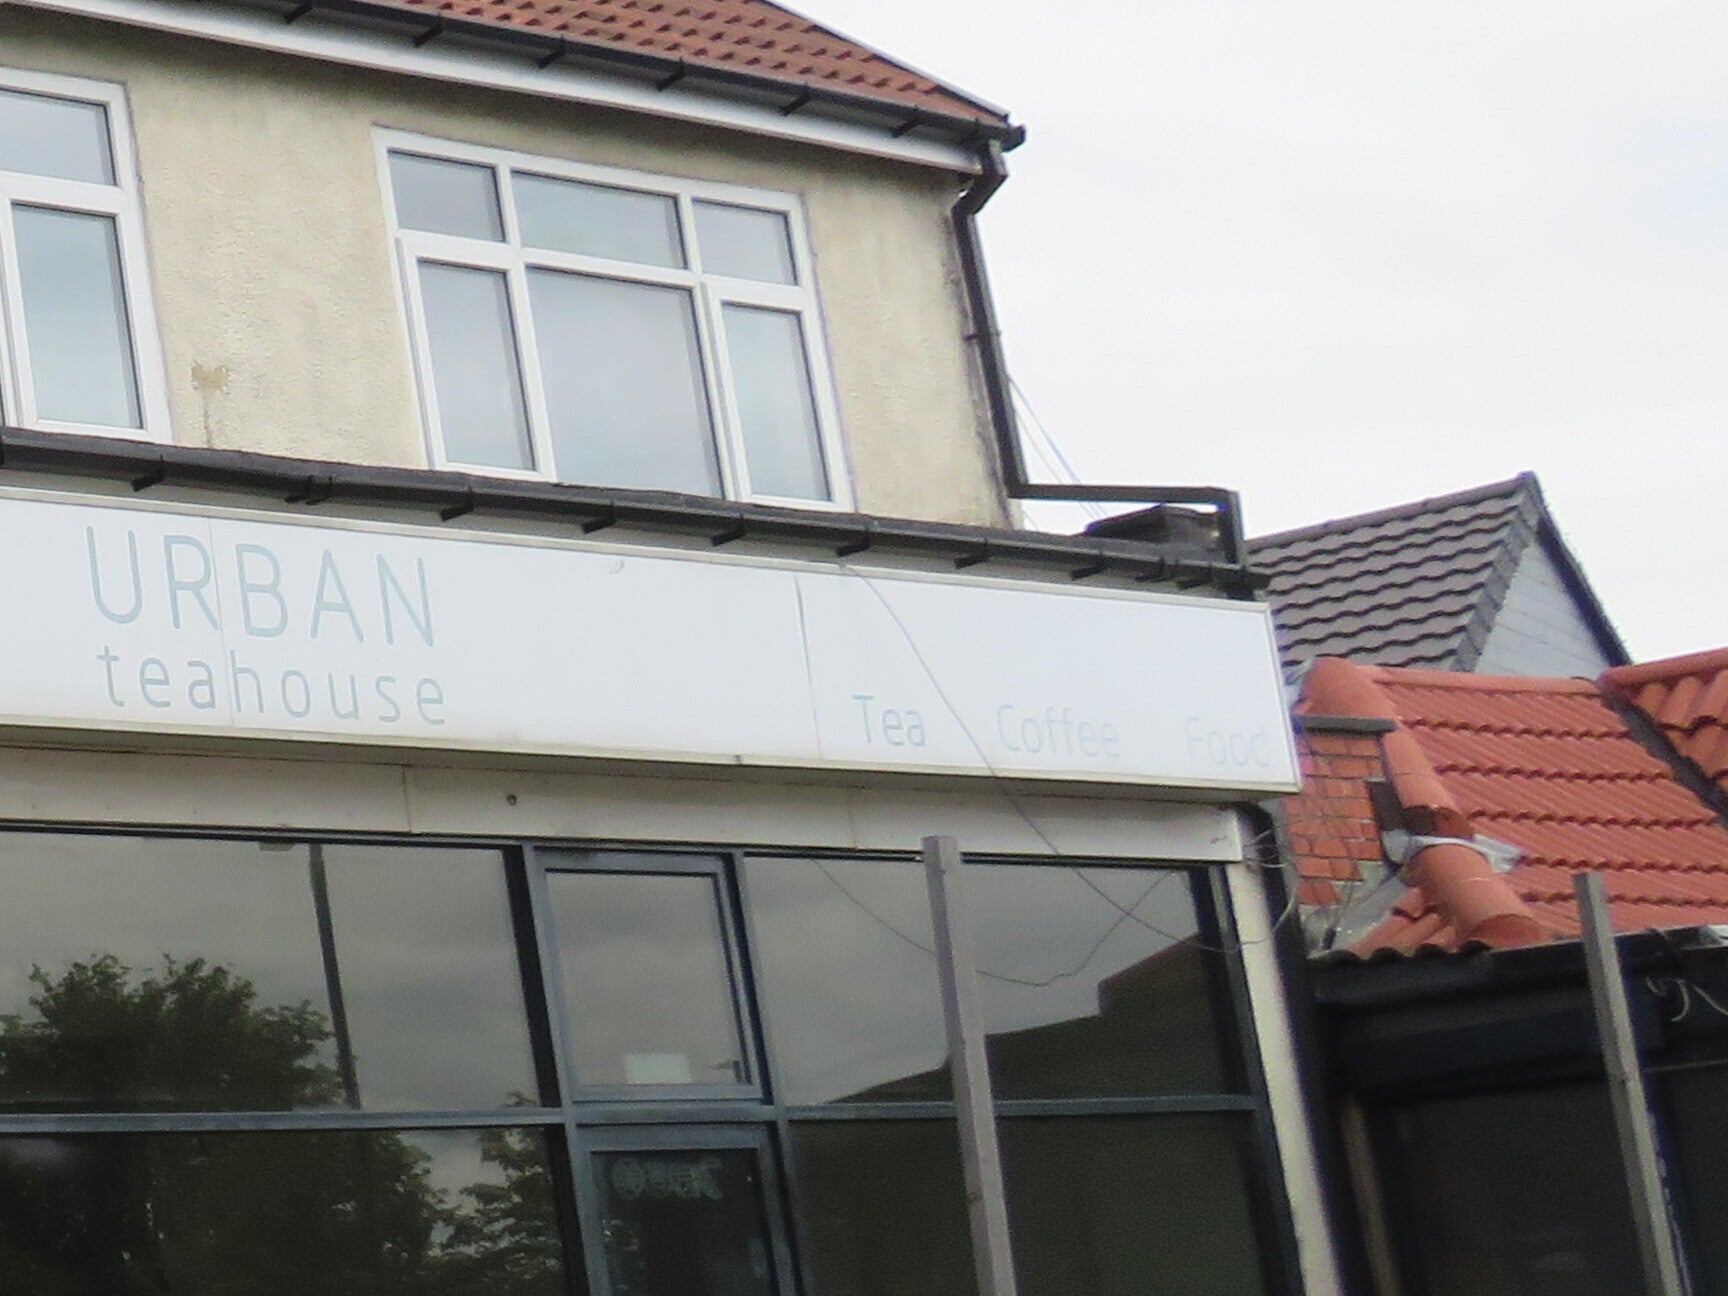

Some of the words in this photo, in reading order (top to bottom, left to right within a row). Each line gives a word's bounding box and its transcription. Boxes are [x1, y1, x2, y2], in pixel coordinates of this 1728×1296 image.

[87, 525, 435, 649] URBAN
[96, 644, 447, 727] teahouse
[851, 693, 927, 748] Tea
[995, 703, 1122, 759] Coffee
[1183, 715, 1272, 769] Food
